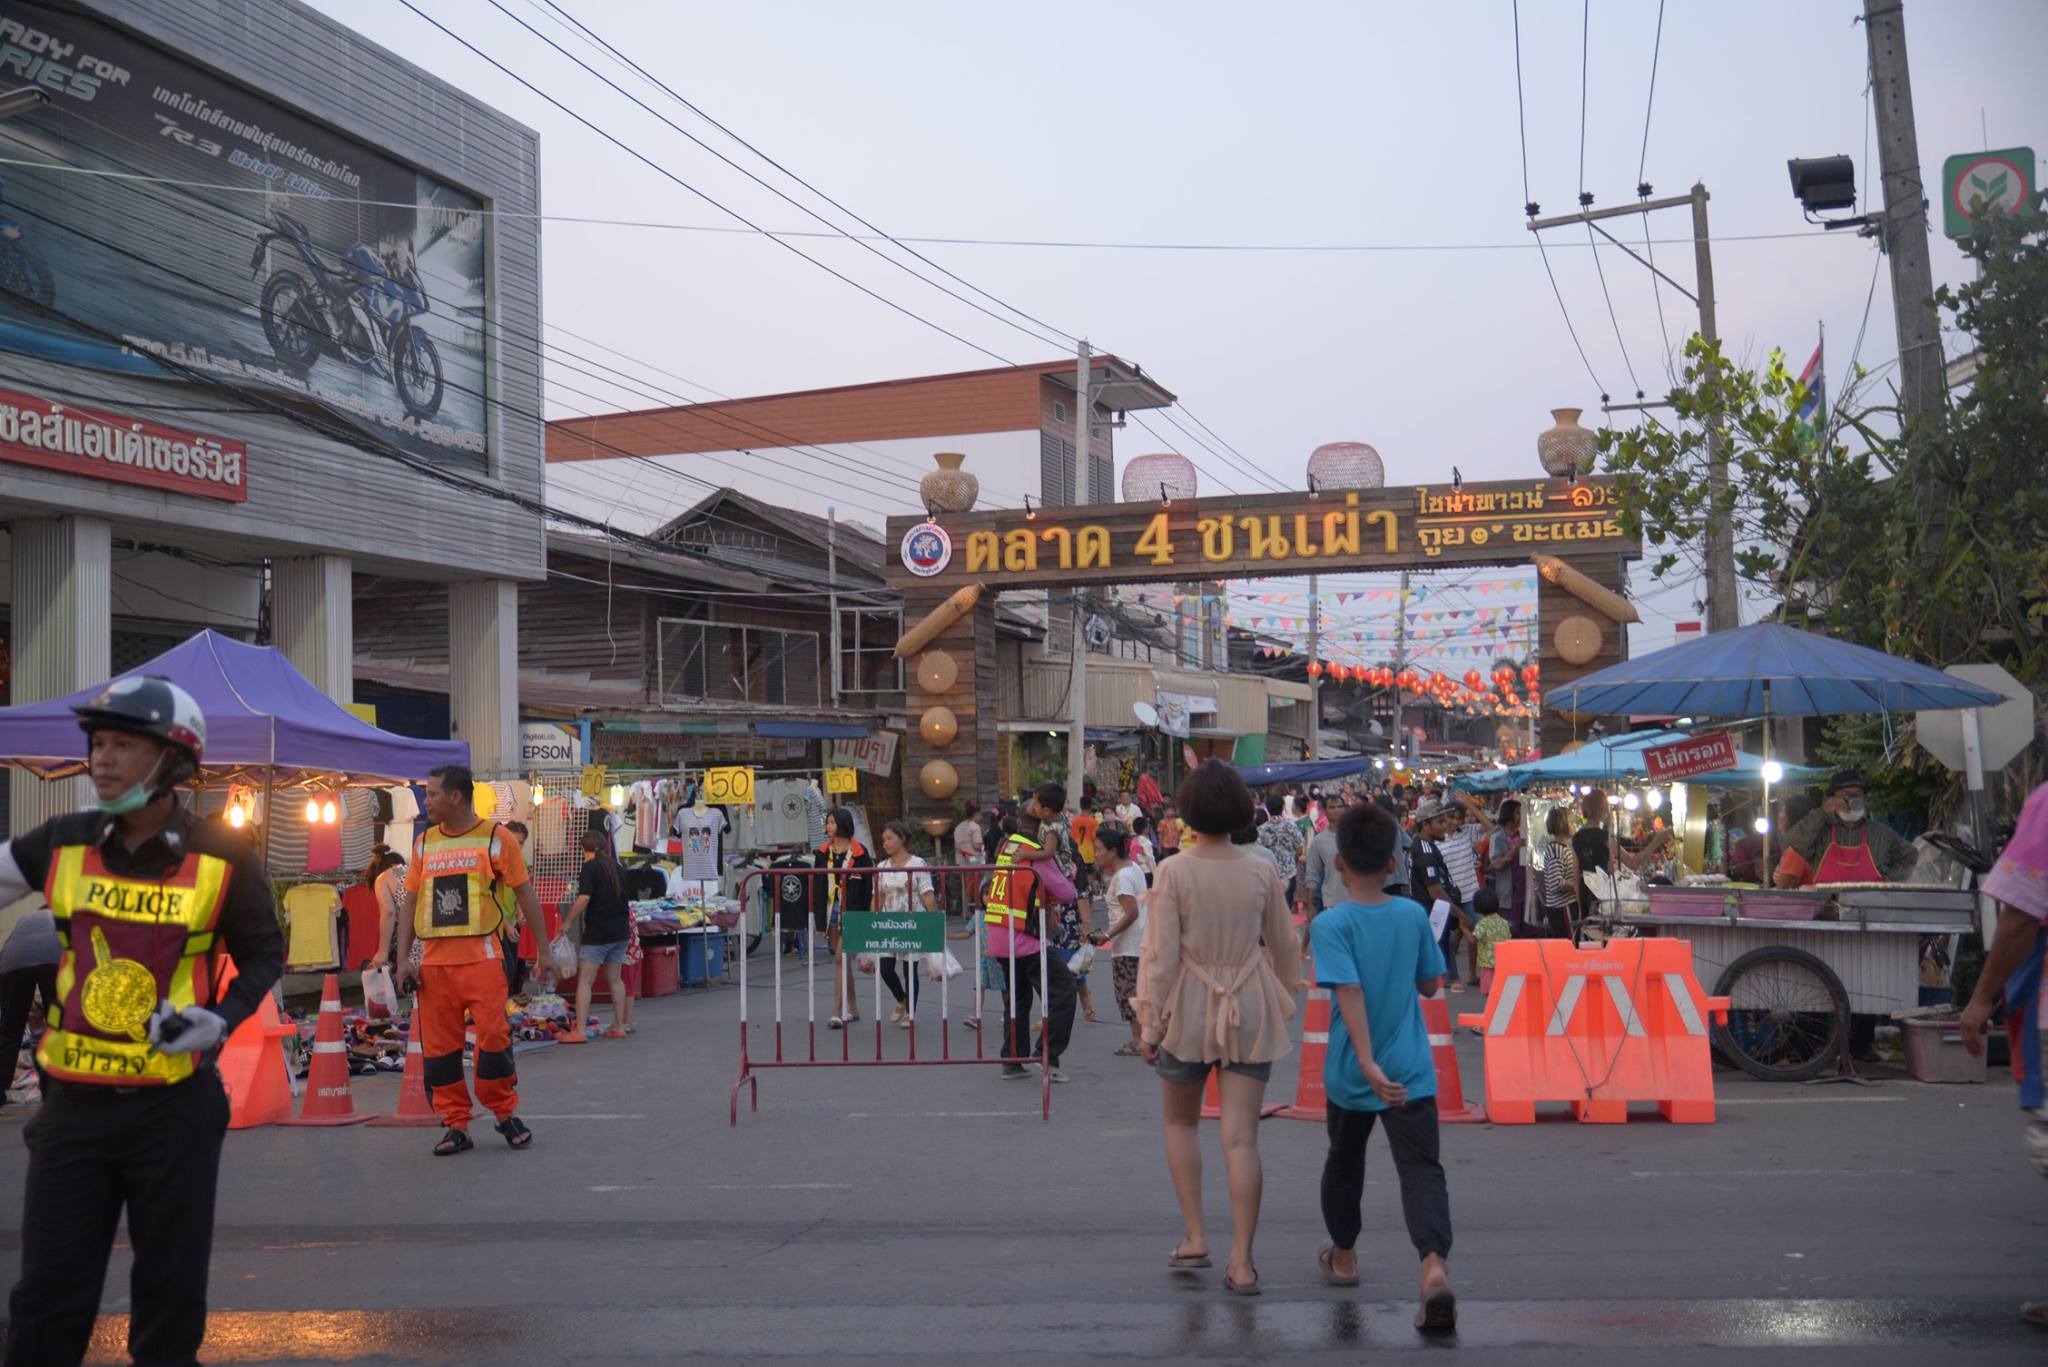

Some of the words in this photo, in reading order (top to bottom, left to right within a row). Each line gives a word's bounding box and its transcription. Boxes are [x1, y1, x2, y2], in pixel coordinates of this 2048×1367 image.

[77, 54, 130, 87] FOR
[966, 525, 1112, 573] ตลาด
[1134, 512, 1175, 566] 4
[1196, 492, 1399, 562] ชนเผ่า
[1418, 526, 1465, 556] กูย
[522, 745, 571, 759] EPSON
[1649, 742, 1726, 769] ไส้กรอก
[583, 773, 601, 796] 50
[711, 770, 750, 798] 50
[828, 772, 855, 791] 50
[1079, 826, 1089, 845] 7
[428, 858, 478, 871] MAXXIS
[87, 882, 184, 917] POLICE
[989, 875, 1008, 901] 14
[63, 1039, 146, 1076] ตำรวจ
